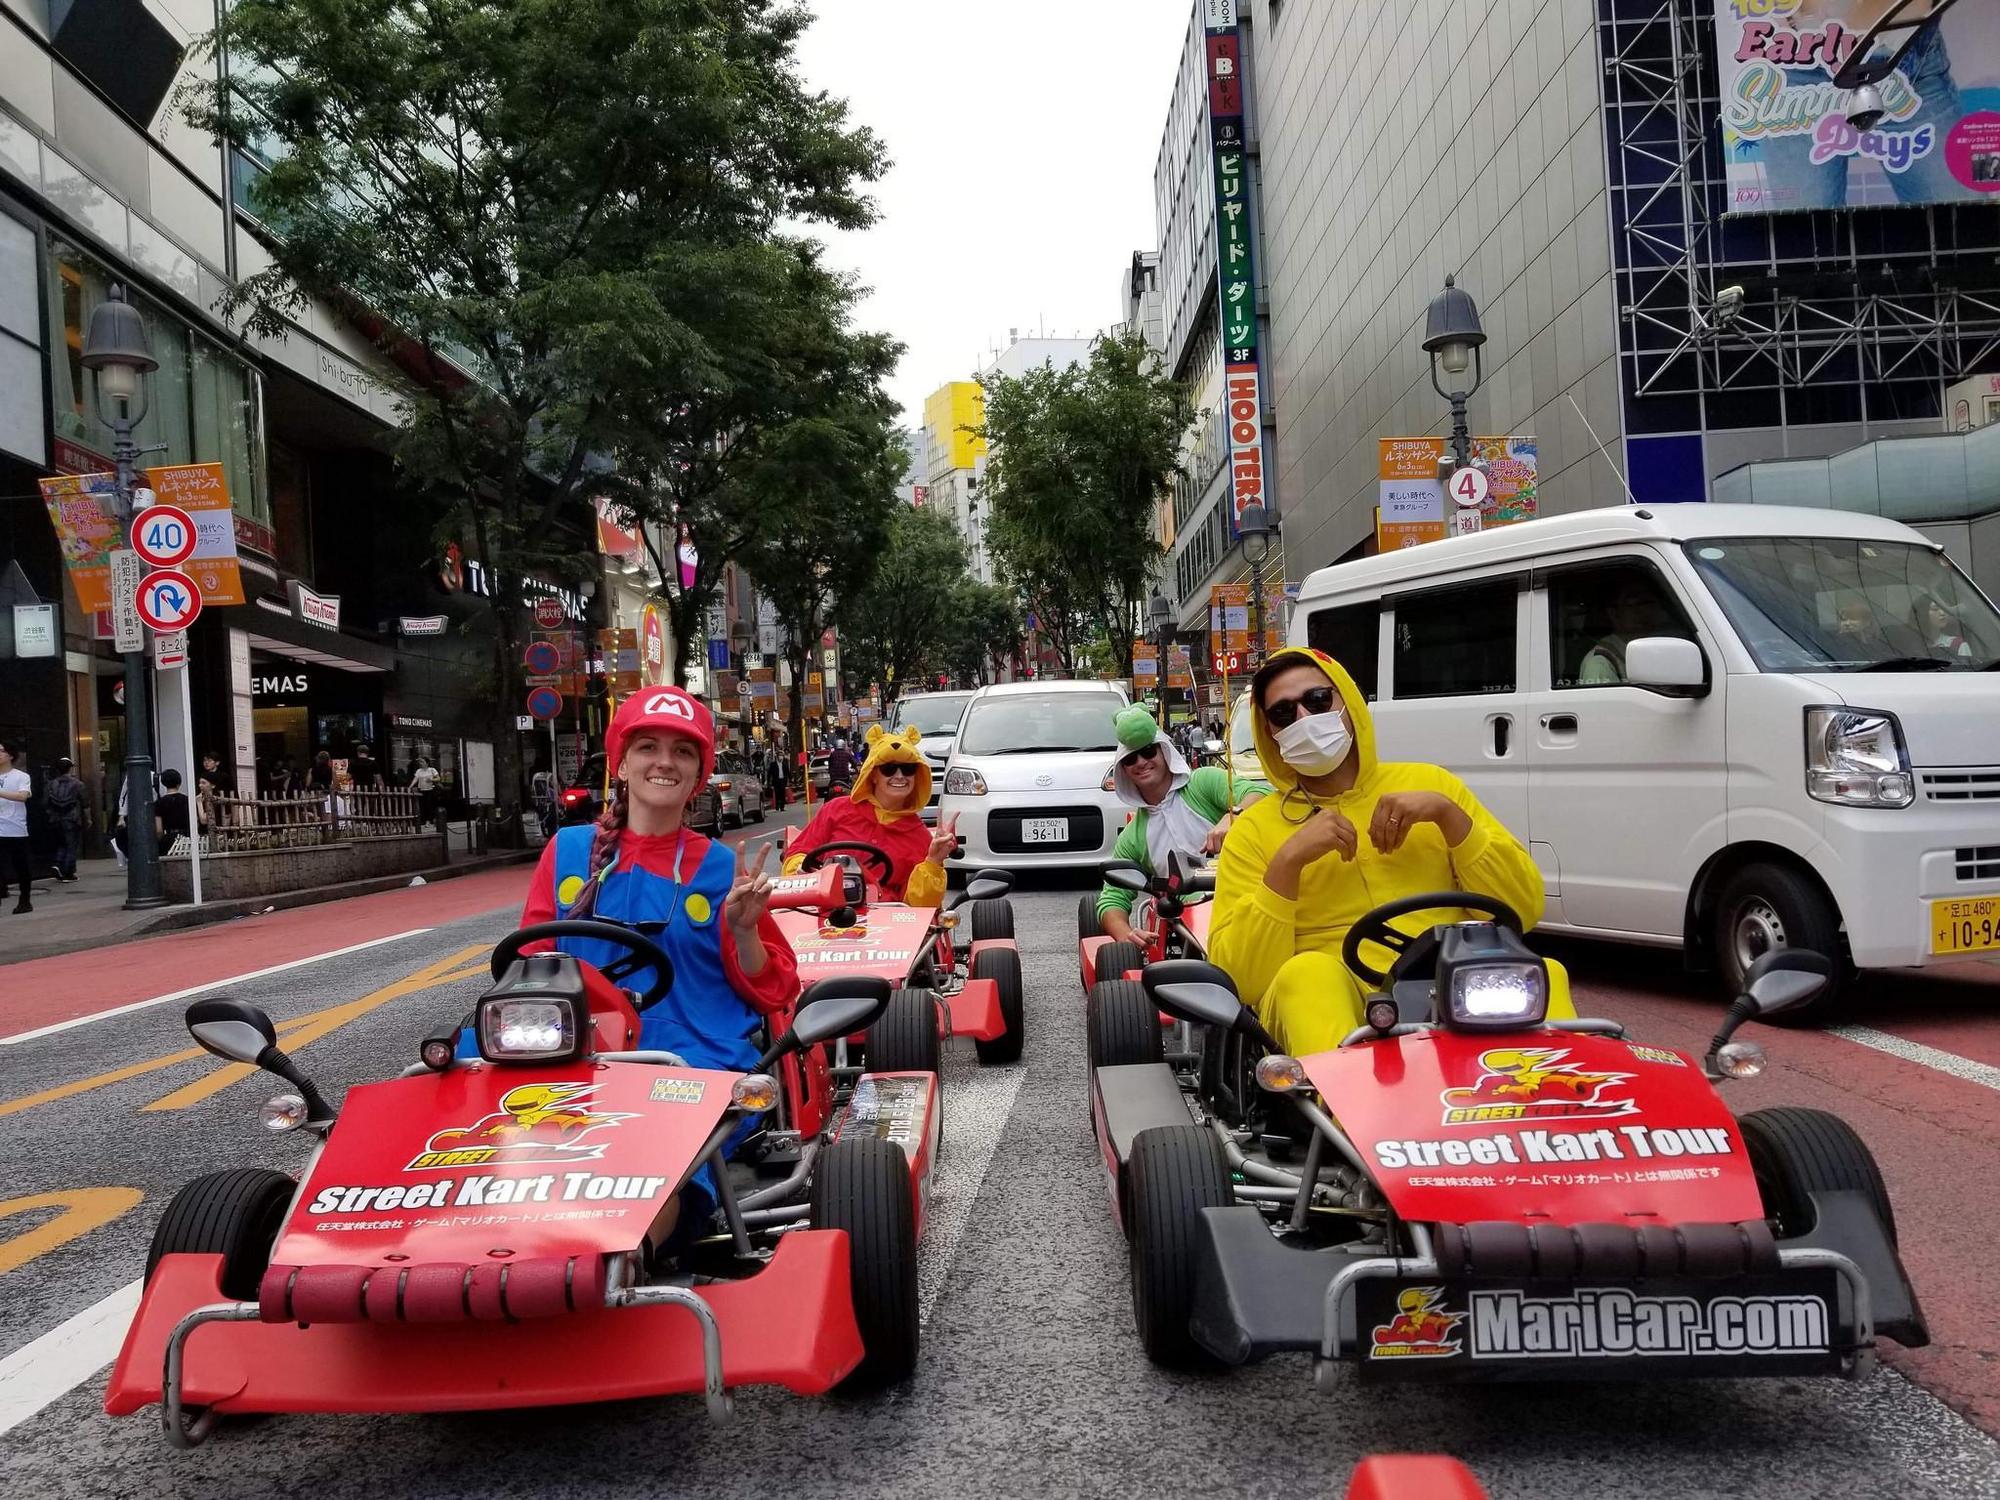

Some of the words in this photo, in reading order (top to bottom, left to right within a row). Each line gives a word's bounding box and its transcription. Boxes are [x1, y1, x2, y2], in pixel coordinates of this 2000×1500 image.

[1812, 114, 1932, 169] Days
[1221, 154, 1249, 345] ビリヤード・ダーツ
[1233, 349, 1249, 362] 3F
[1229, 378, 1263, 513] HOOTERS
[1392, 441, 1431, 450] SHIBUYA
[1385, 450, 1438, 461] ルネッサンス
[163, 469, 209, 480] SHIBUYA
[1486, 469, 1531, 480] ネッサンス
[160, 478, 221, 493] ルネッサンス
[1458, 473, 1477, 499] 4
[1388, 491, 1435, 500] 美しい時代へ
[147, 523, 182, 550] 40
[121, 556, 135, 637] 防犯カメラ作動中
[538, 607, 562, 619] 消火栓
[740, 681, 748, 692] 5
[649, 696, 690, 717] M
[412, 718, 432, 728] CINEMAS
[520, 717, 527, 727] P
[1032, 828, 1065, 840] 96-11
[1951, 903, 1971, 917] 足立
[1974, 901, 1991, 915] 480
[820, 950, 862, 963] Kart
[866, 950, 911, 961] Tour
[1450, 1106, 1526, 1122] STREET
[1374, 1135, 1519, 1168] Street
[1519, 1127, 1624, 1162] Kart
[1620, 1125, 1732, 1158] Tour
[413, 1149, 498, 1169] STREET
[309, 1184, 452, 1215] Street
[455, 1174, 555, 1207] Kart
[560, 1172, 666, 1201] Tour
[1473, 1291, 1828, 1354] MariCar.com
